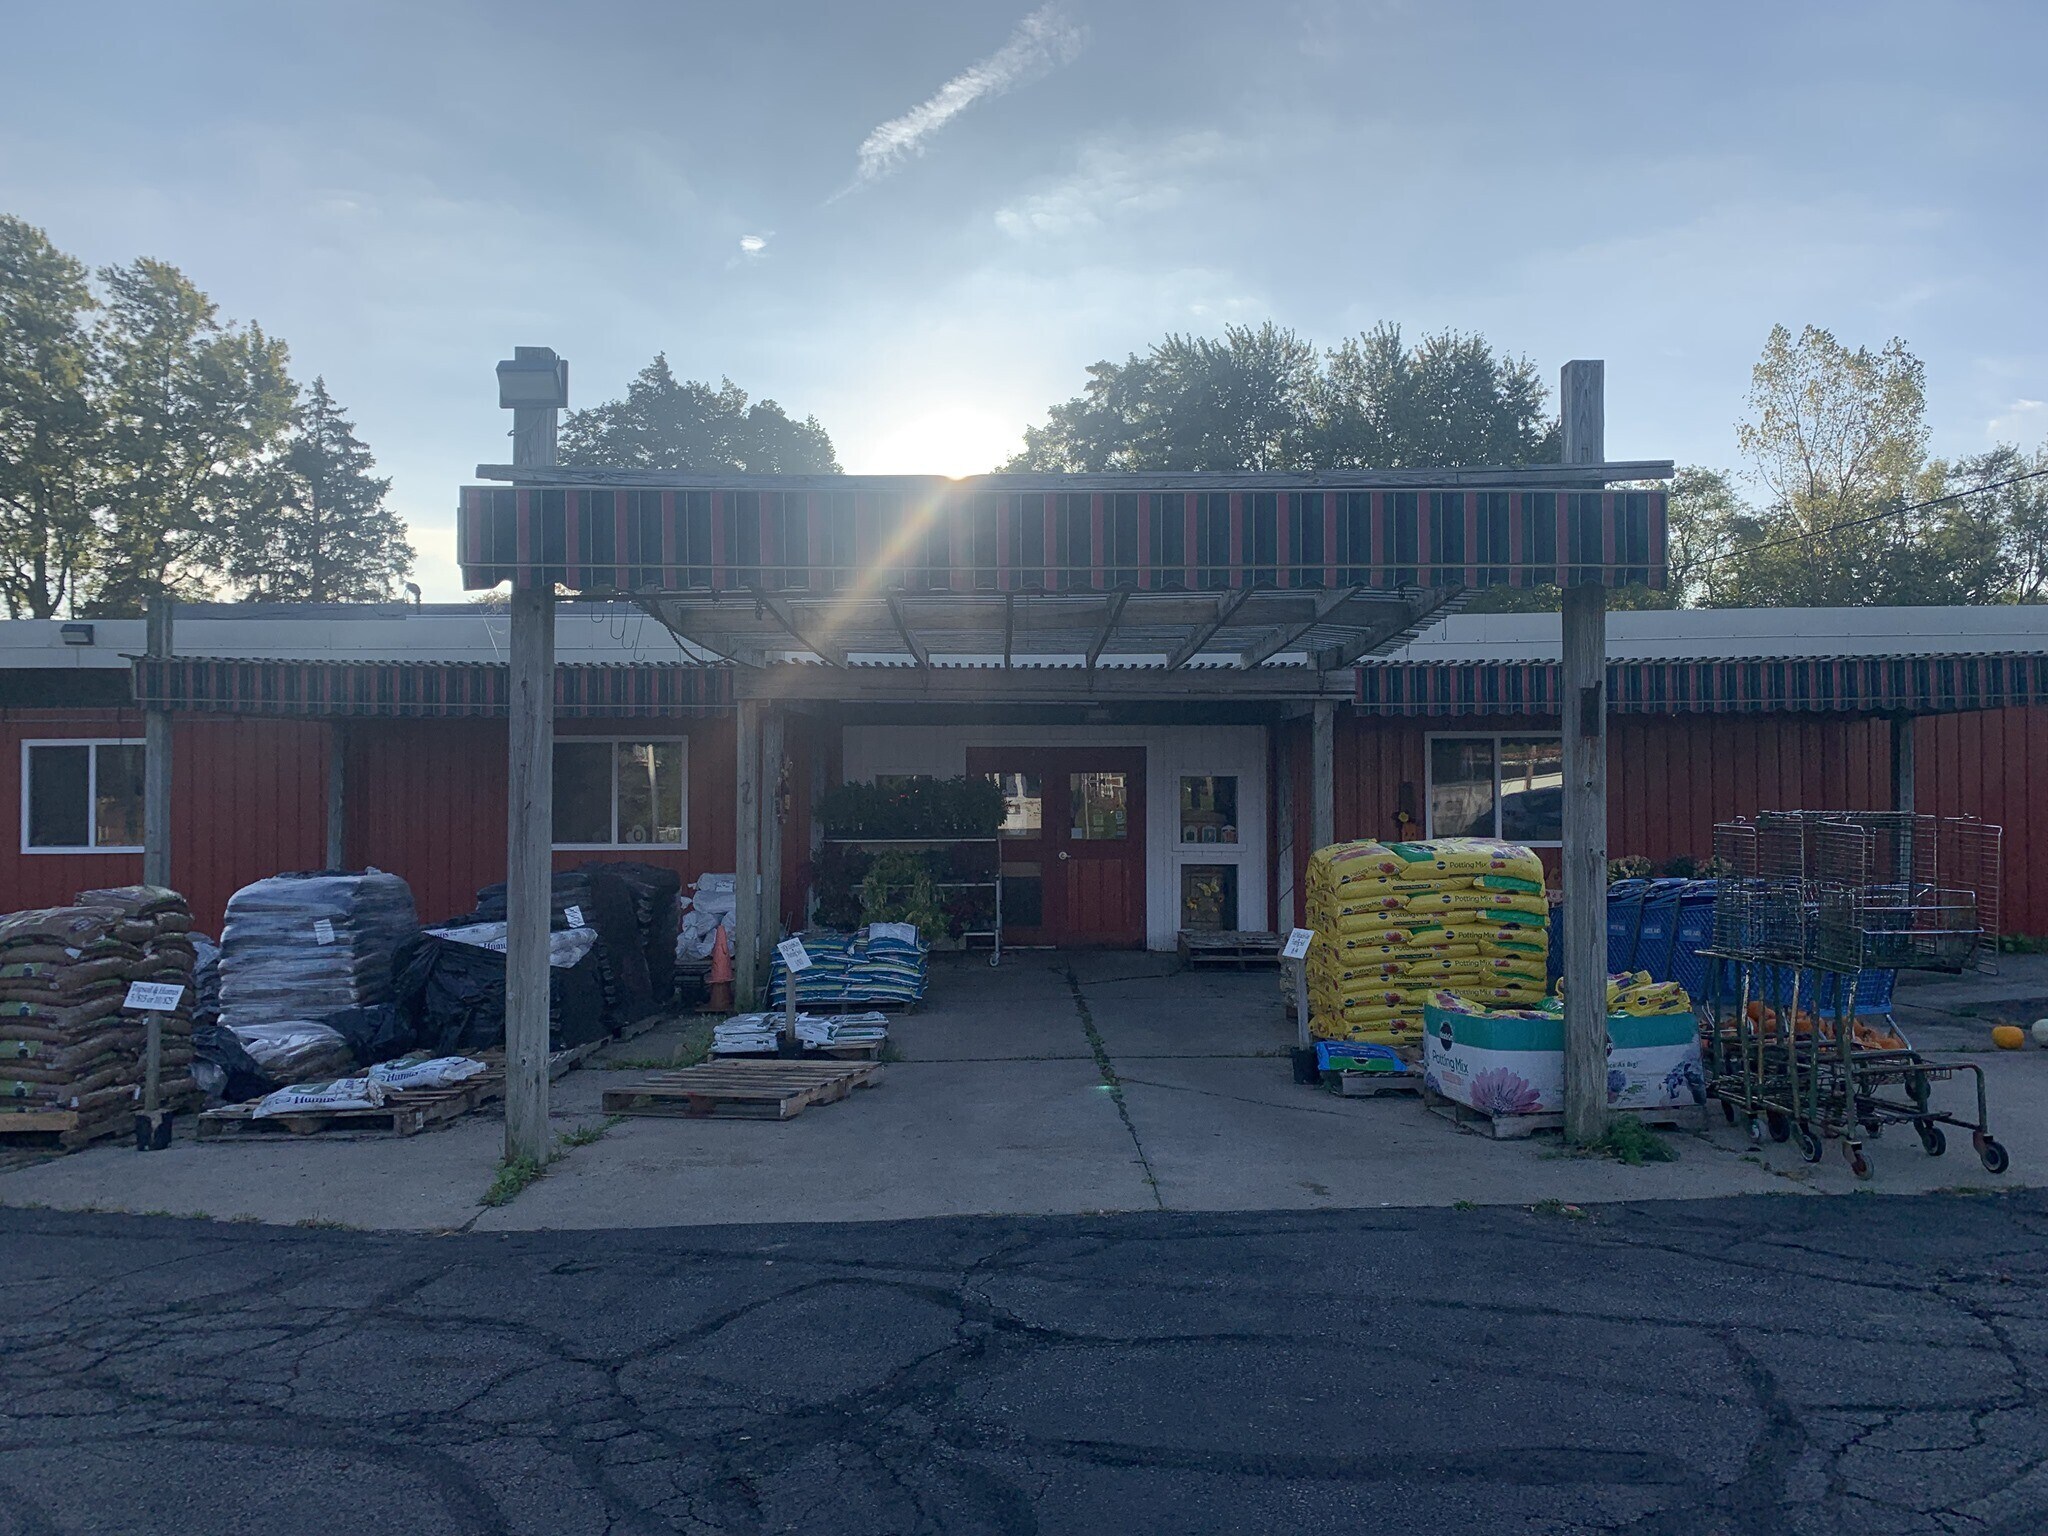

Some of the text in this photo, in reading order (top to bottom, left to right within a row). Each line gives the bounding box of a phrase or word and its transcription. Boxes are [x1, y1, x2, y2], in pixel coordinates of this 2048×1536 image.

[1450, 861, 1475, 869] Potting
[1455, 896, 1479, 904] Potting
[1459, 931, 1482, 939] Potting
[1433, 1049, 1469, 1074] Potting Mix
[387, 1071, 418, 1082] Humus
[293, 1095, 335, 1104] Humus
